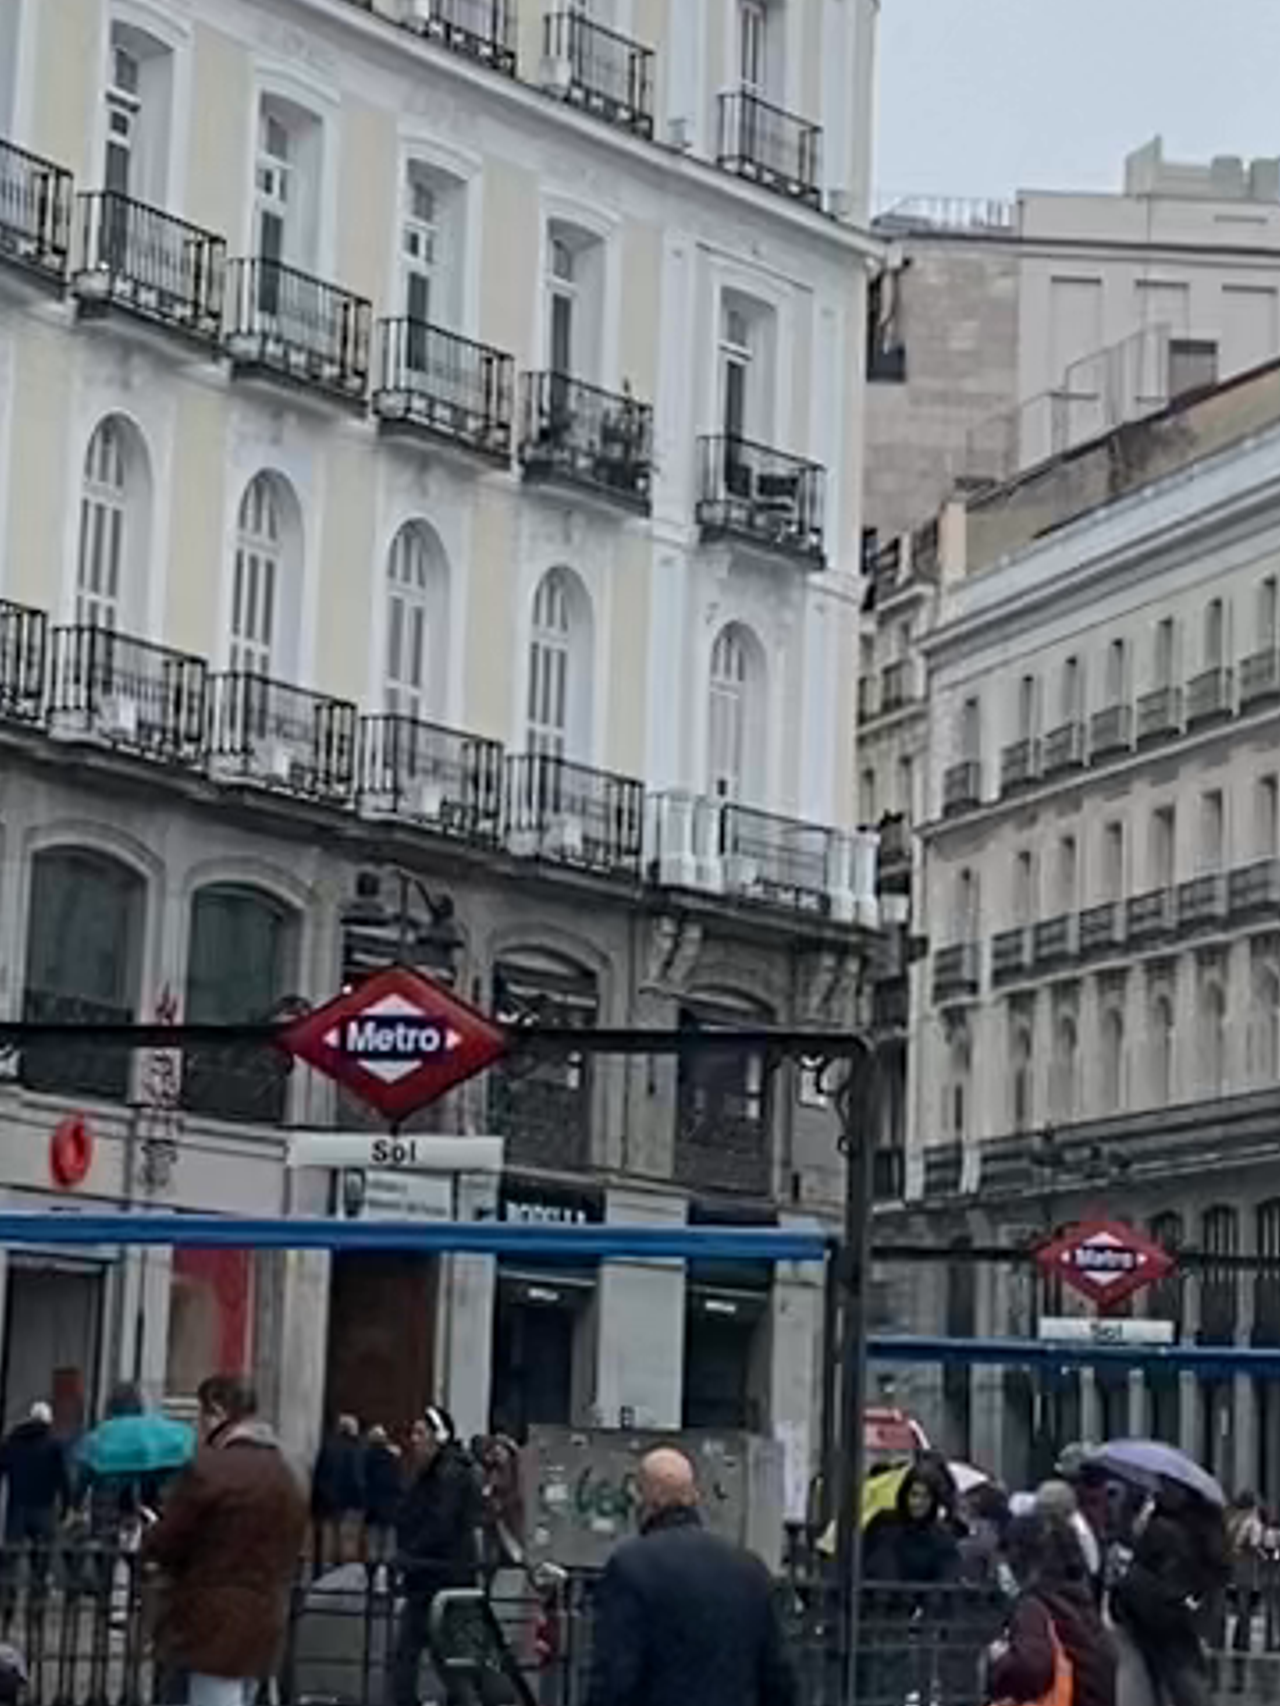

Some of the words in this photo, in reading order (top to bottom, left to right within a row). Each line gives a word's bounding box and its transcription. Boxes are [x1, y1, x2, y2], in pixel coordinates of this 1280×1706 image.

[346, 1021, 441, 1053] Metro
[372, 1140, 417, 1163] Sol
[1075, 1248, 1134, 1269] Metro
